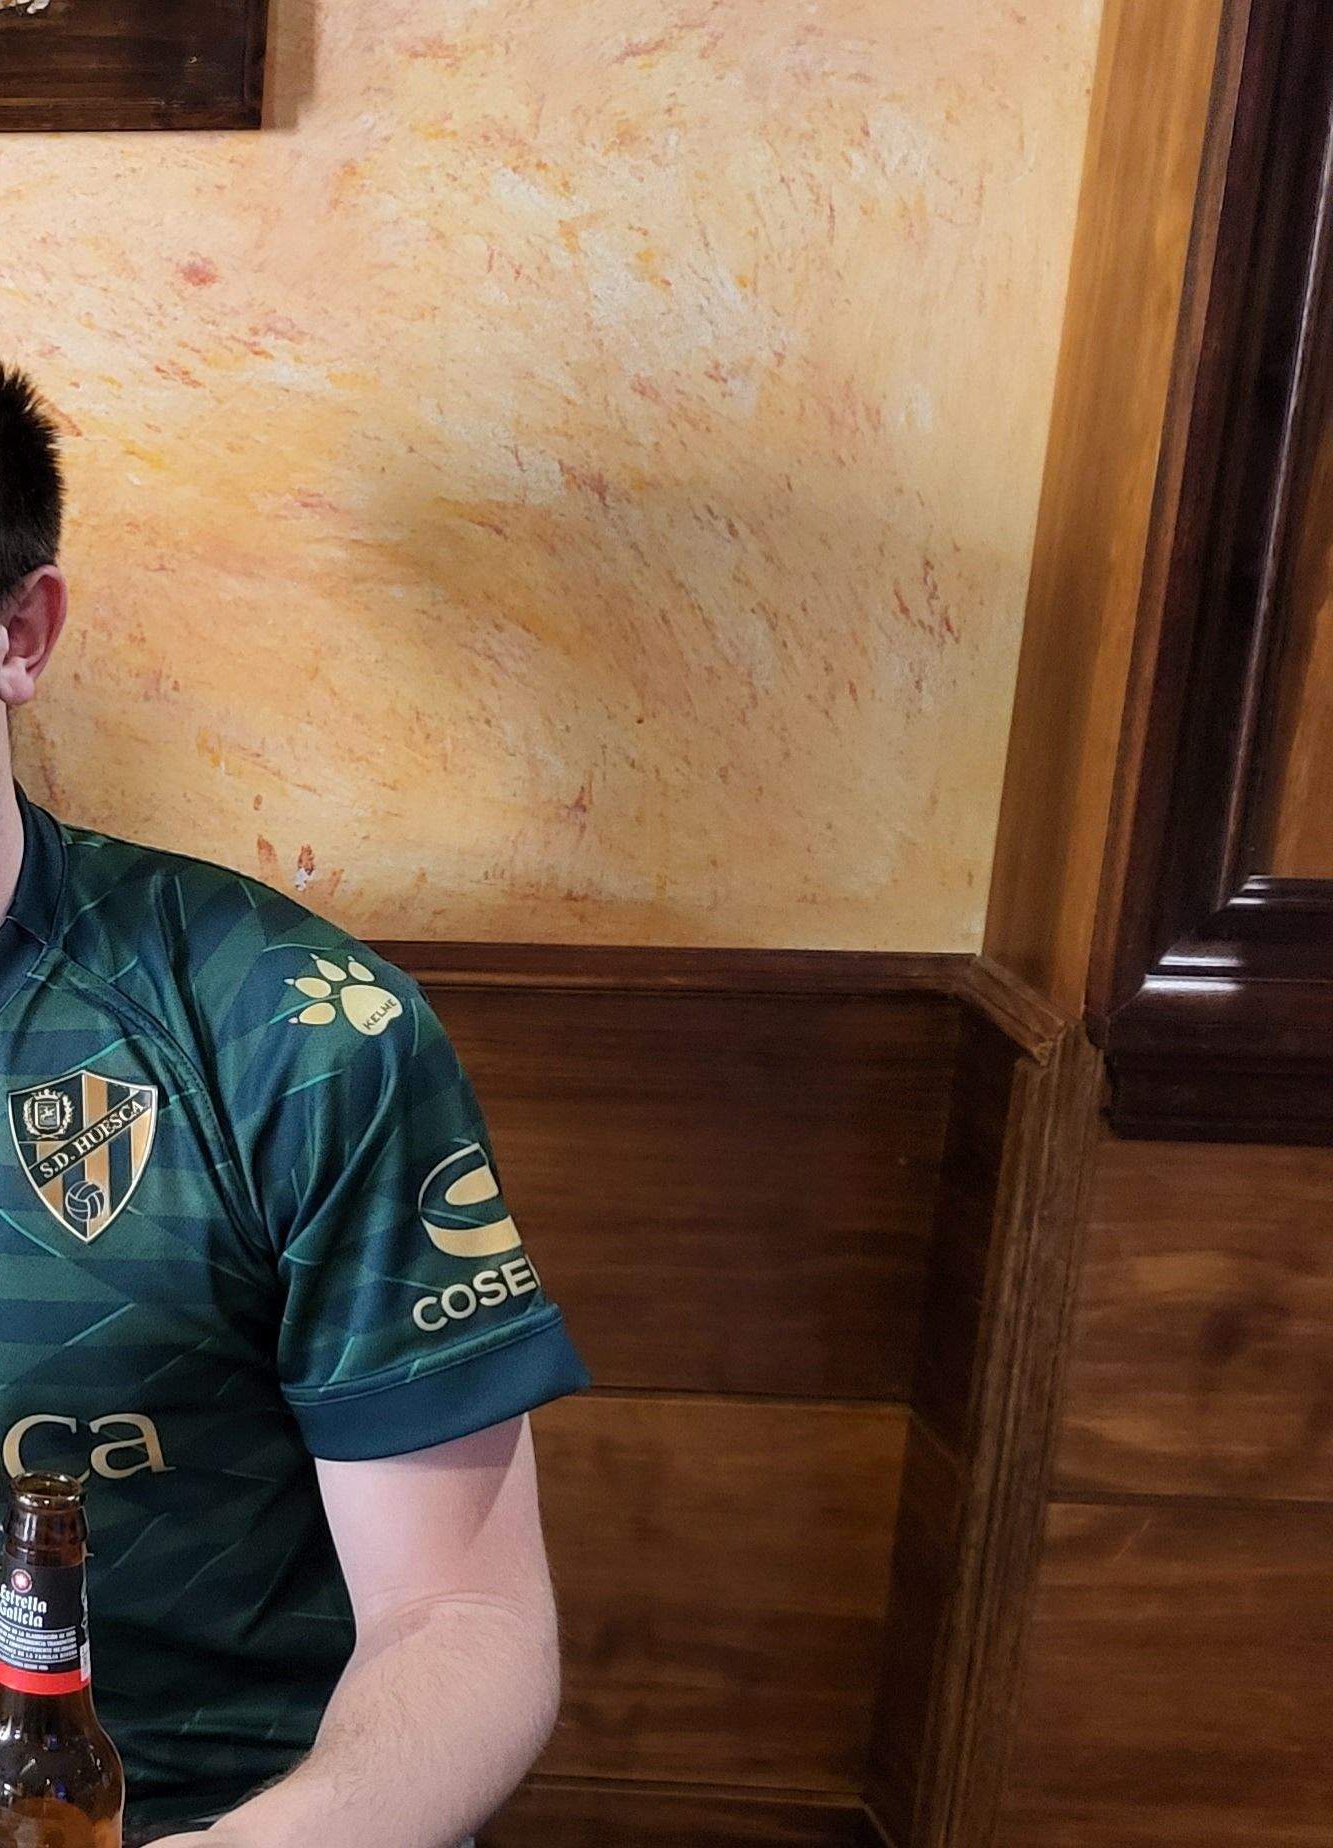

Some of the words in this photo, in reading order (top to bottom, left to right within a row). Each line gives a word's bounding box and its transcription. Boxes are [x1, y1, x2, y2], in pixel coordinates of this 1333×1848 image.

[362, 998, 397, 1030] KELME
[40, 1152, 75, 1178] S.D.
[73, 1100, 144, 1156] HUESCA
[413, 1254, 541, 1331] COSE
[0, 1583, 47, 1614] Estrella
[0, 1600, 43, 1628] Galicia
